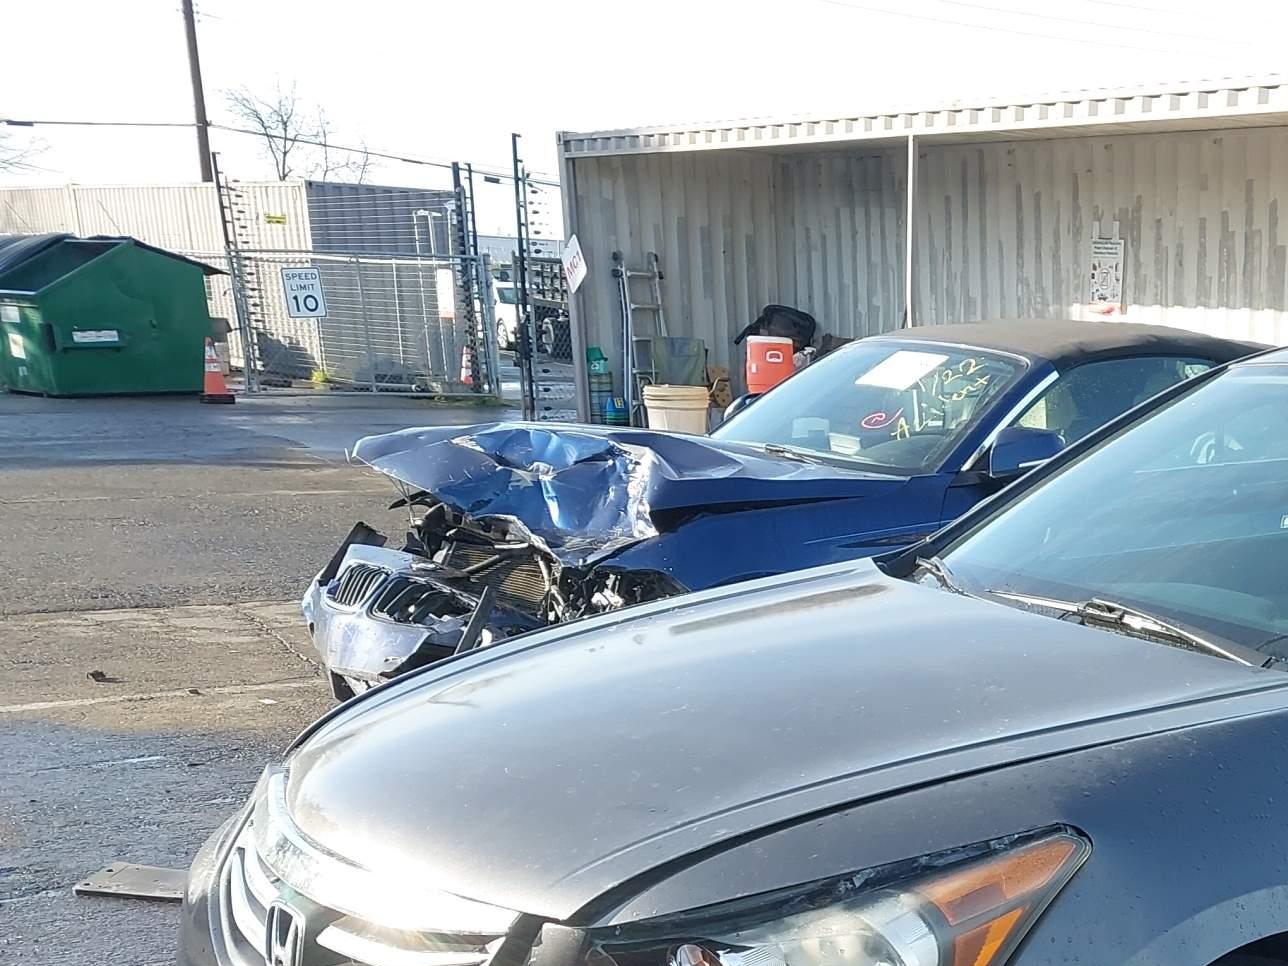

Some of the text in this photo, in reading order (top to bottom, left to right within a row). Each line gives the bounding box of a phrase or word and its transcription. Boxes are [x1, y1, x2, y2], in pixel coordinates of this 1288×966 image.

[285, 272, 317, 280] SPEED
[290, 283, 315, 291] LIMIT
[292, 294, 319, 312] 10
